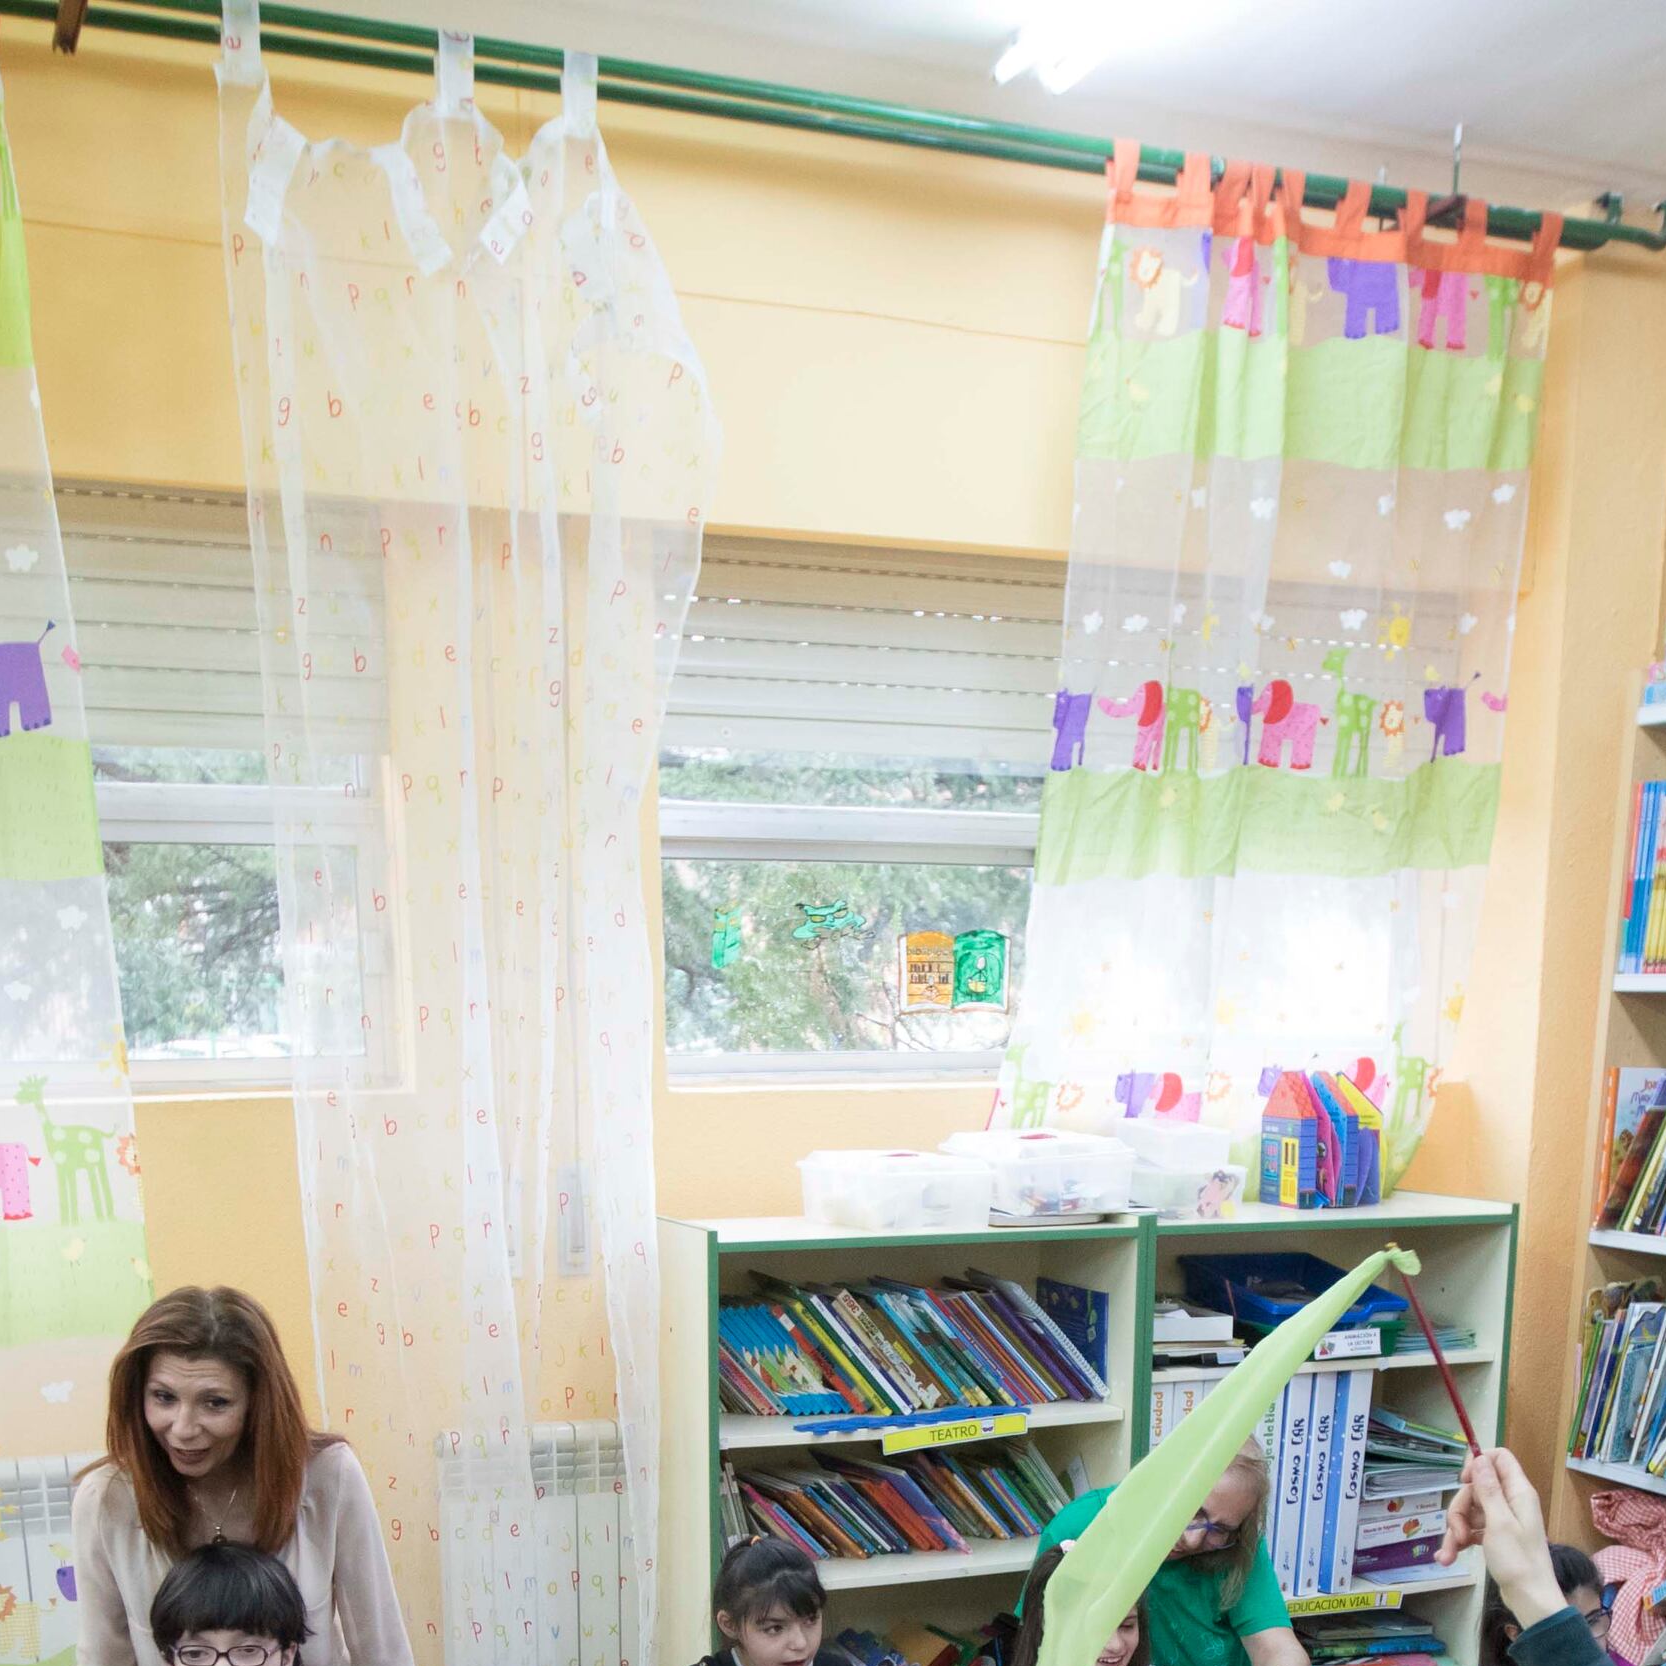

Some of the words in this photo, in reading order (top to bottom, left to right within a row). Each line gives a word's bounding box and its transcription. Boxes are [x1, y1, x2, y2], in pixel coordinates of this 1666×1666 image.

[842, 1293, 860, 1314] 365
[1153, 1391, 1164, 1436] ciudad
[929, 1423, 978, 1442] TEATRO
[1291, 1418, 1305, 1445] CAR
[1317, 1415, 1330, 1442] CAR
[1351, 1414, 1365, 1441] CAR
[1349, 1596, 1371, 1607] VIAL
